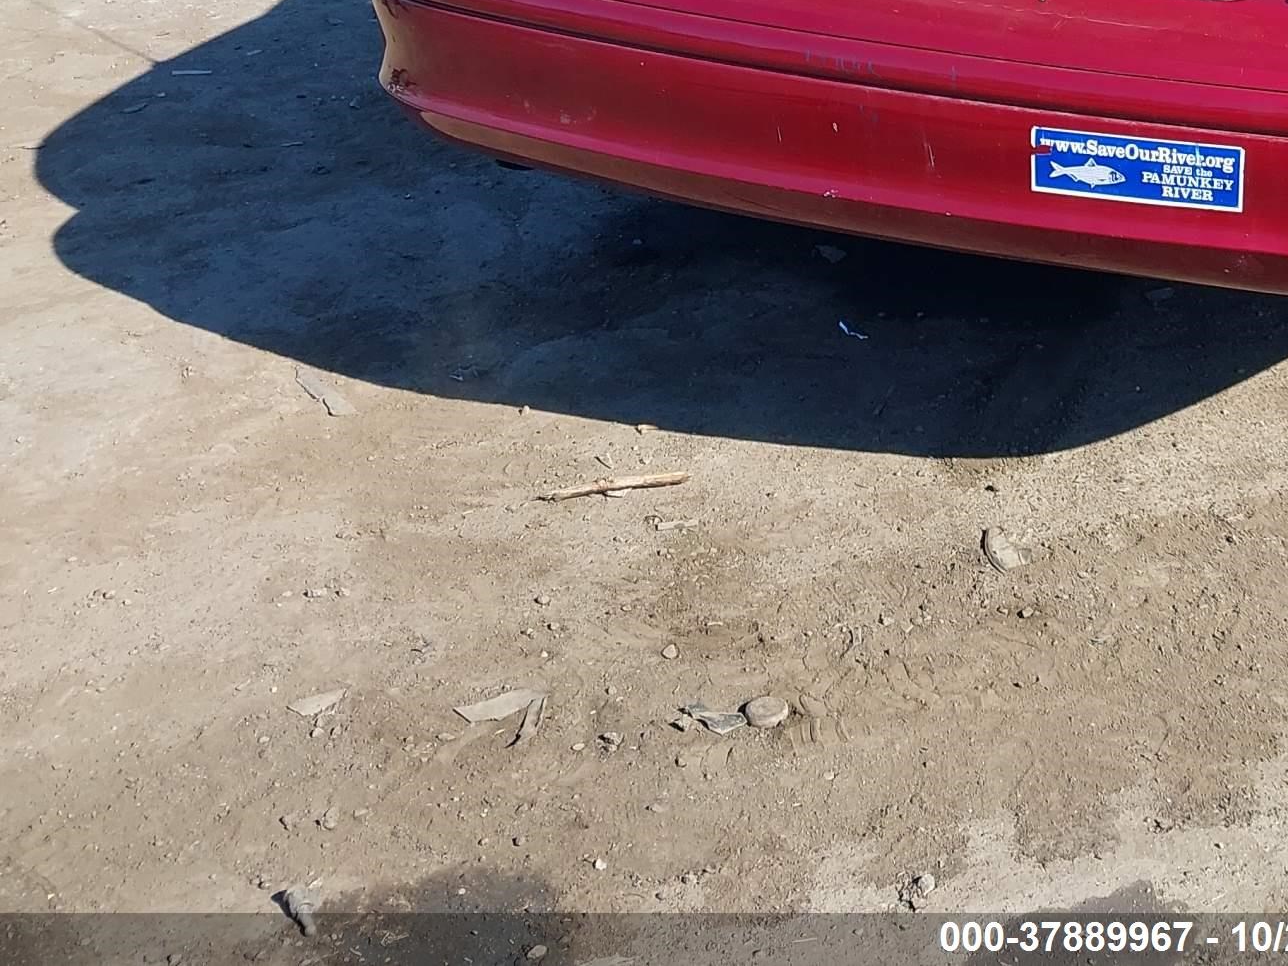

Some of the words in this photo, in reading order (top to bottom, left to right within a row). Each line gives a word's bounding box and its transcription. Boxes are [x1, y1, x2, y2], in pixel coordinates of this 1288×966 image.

[1163, 164, 1193, 176] SAVE
[1196, 167, 1213, 178] the
[1142, 170, 1234, 192] PAMUNKEY
[1162, 186, 1214, 202] RIVER
